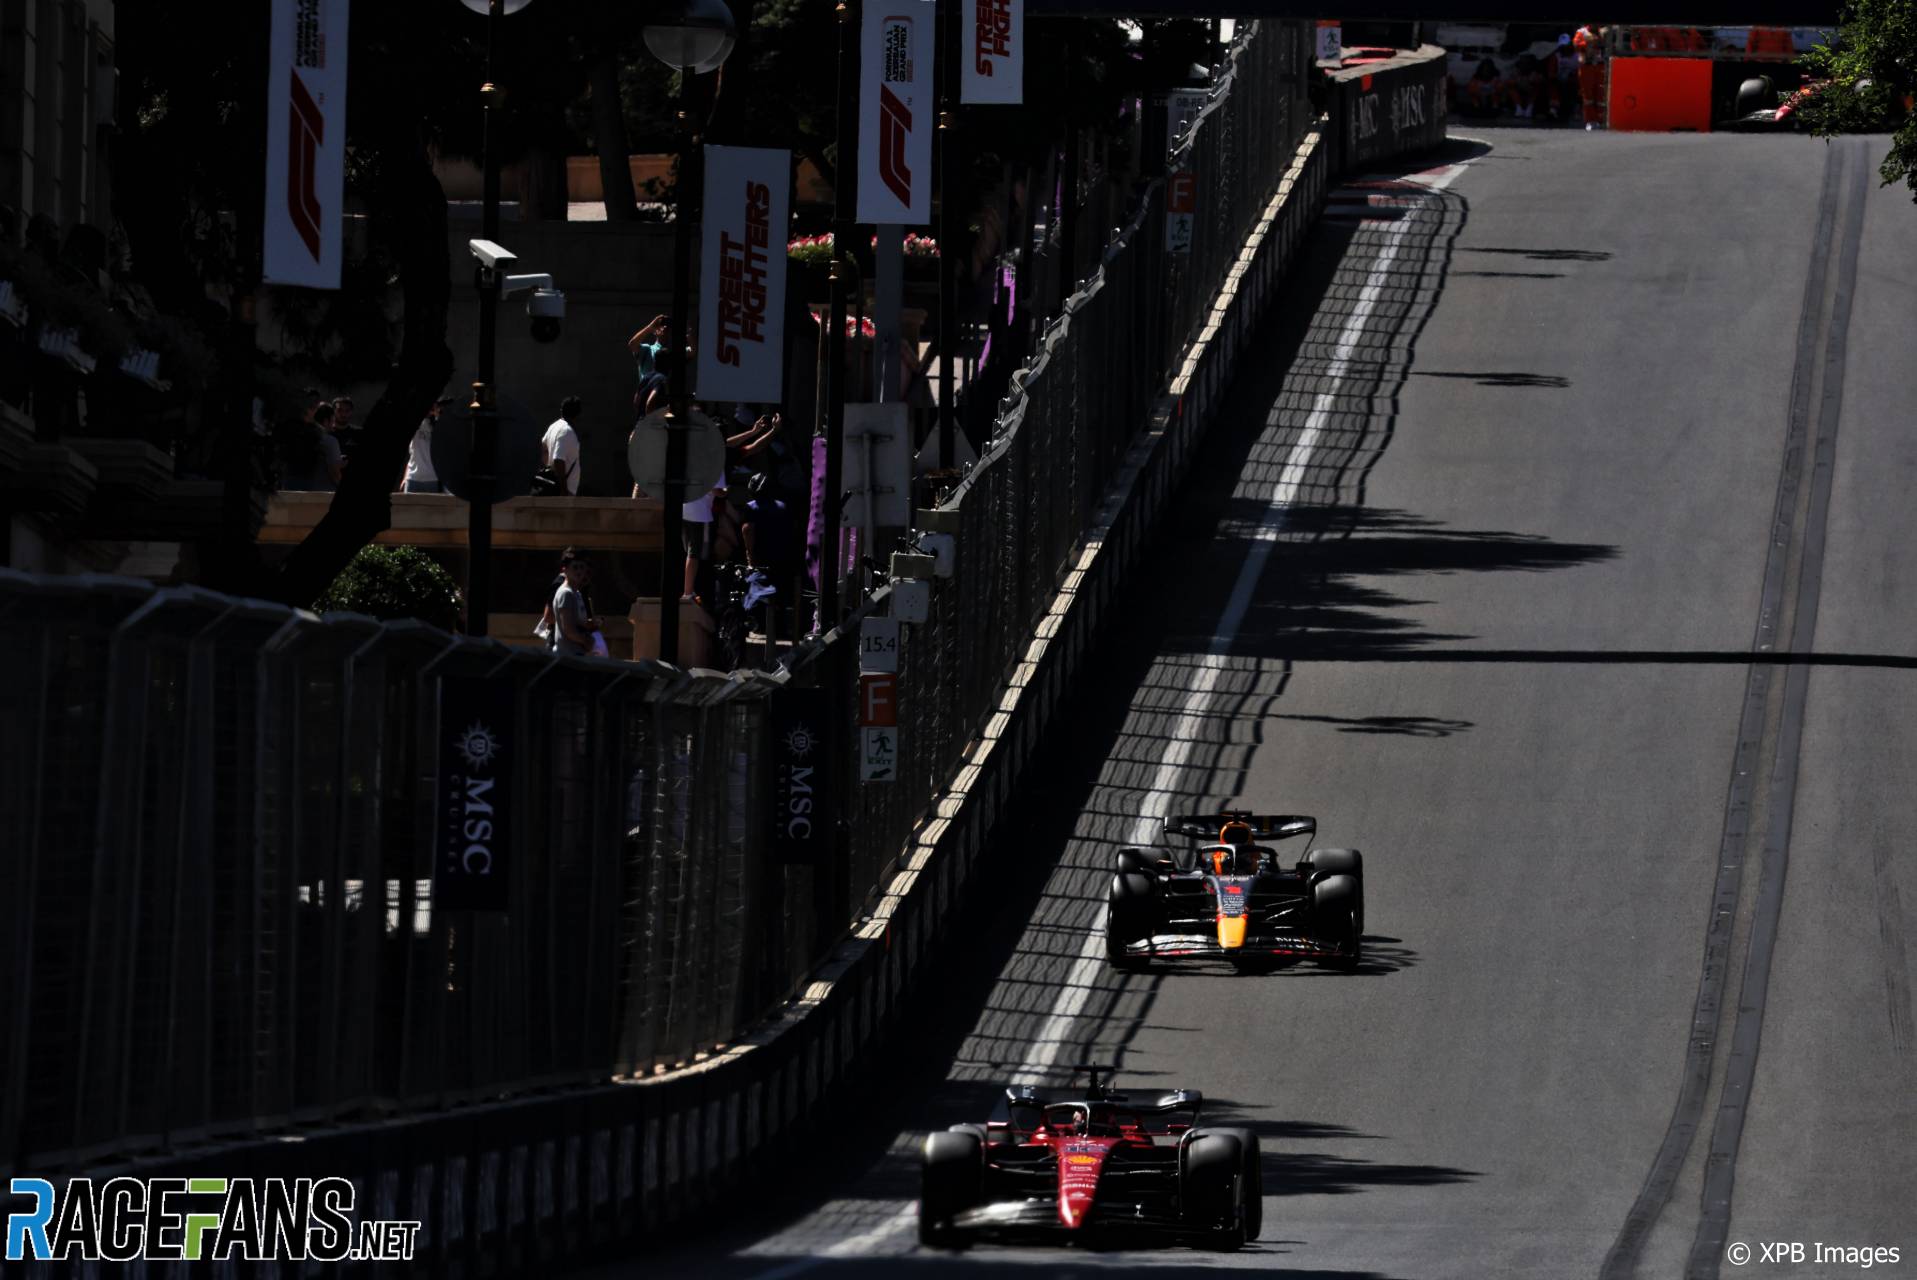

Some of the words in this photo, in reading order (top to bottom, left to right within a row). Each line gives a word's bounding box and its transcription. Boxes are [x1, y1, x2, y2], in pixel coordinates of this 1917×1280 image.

[1173, 178, 1193, 208] F
[717, 231, 745, 368] STREET
[742, 181, 770, 343] FIGHTERS
[865, 636, 897, 652] 15.4
[868, 681, 892, 721] F
[462, 776, 496, 875] MSC
[788, 764, 815, 840] MSC
